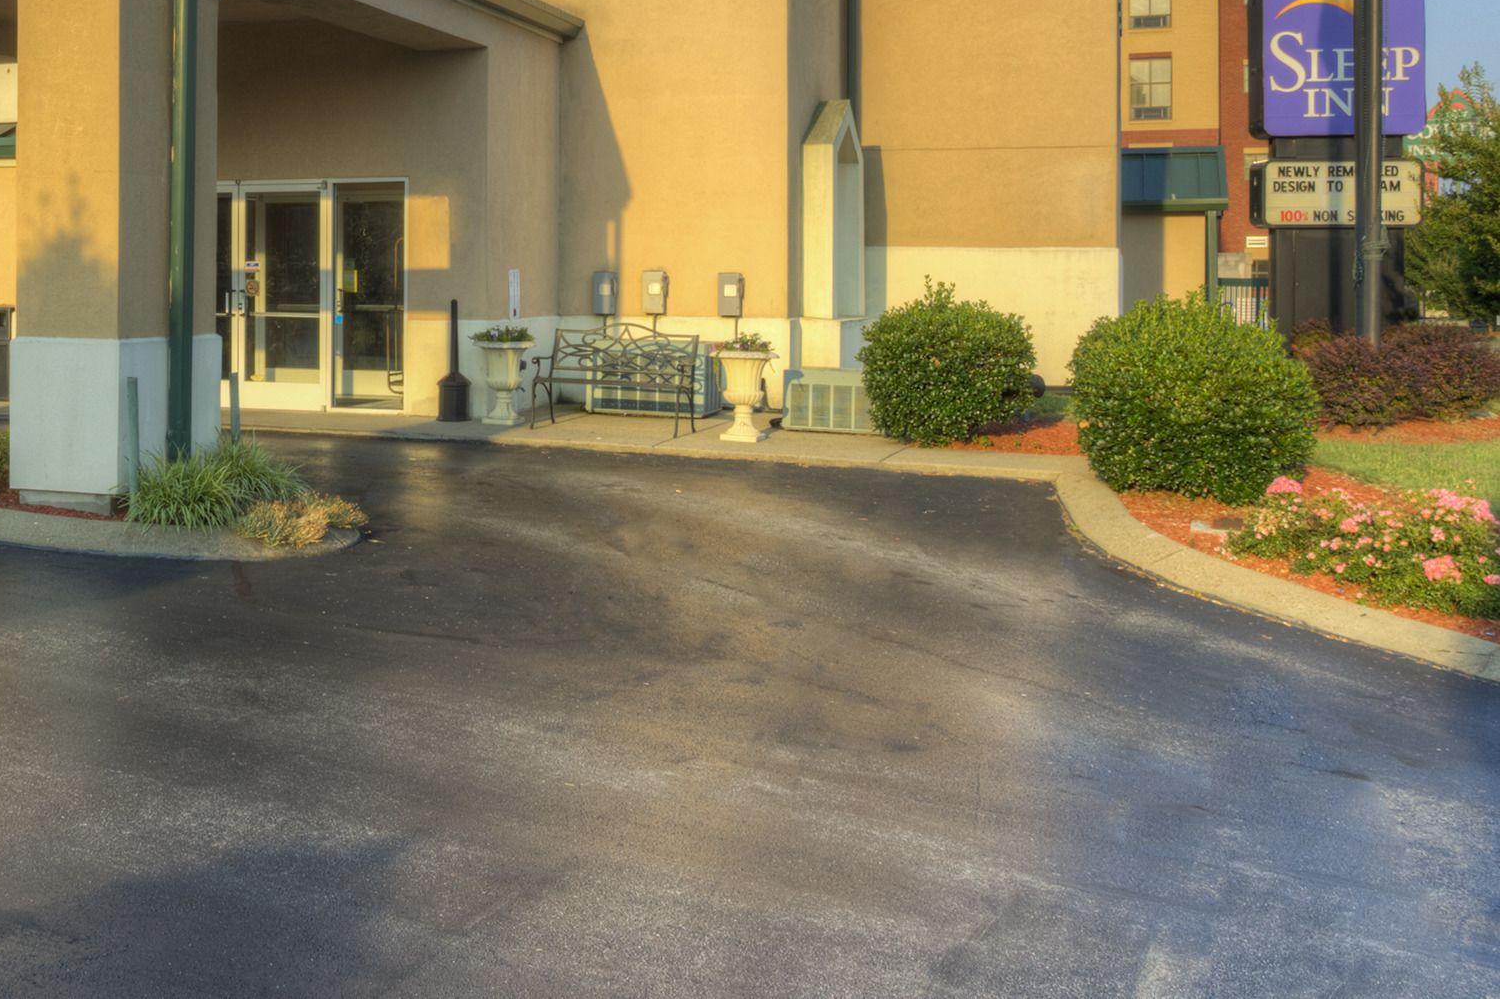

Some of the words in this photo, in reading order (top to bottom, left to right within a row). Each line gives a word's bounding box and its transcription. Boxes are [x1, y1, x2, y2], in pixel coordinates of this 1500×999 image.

[1269, 31, 1420, 92] SLEP
[1278, 166, 1320, 178] NEWLY
[1273, 181, 1316, 193] DESIGN
[1327, 180, 1344, 193] TO
[1313, 210, 1338, 222] NON
